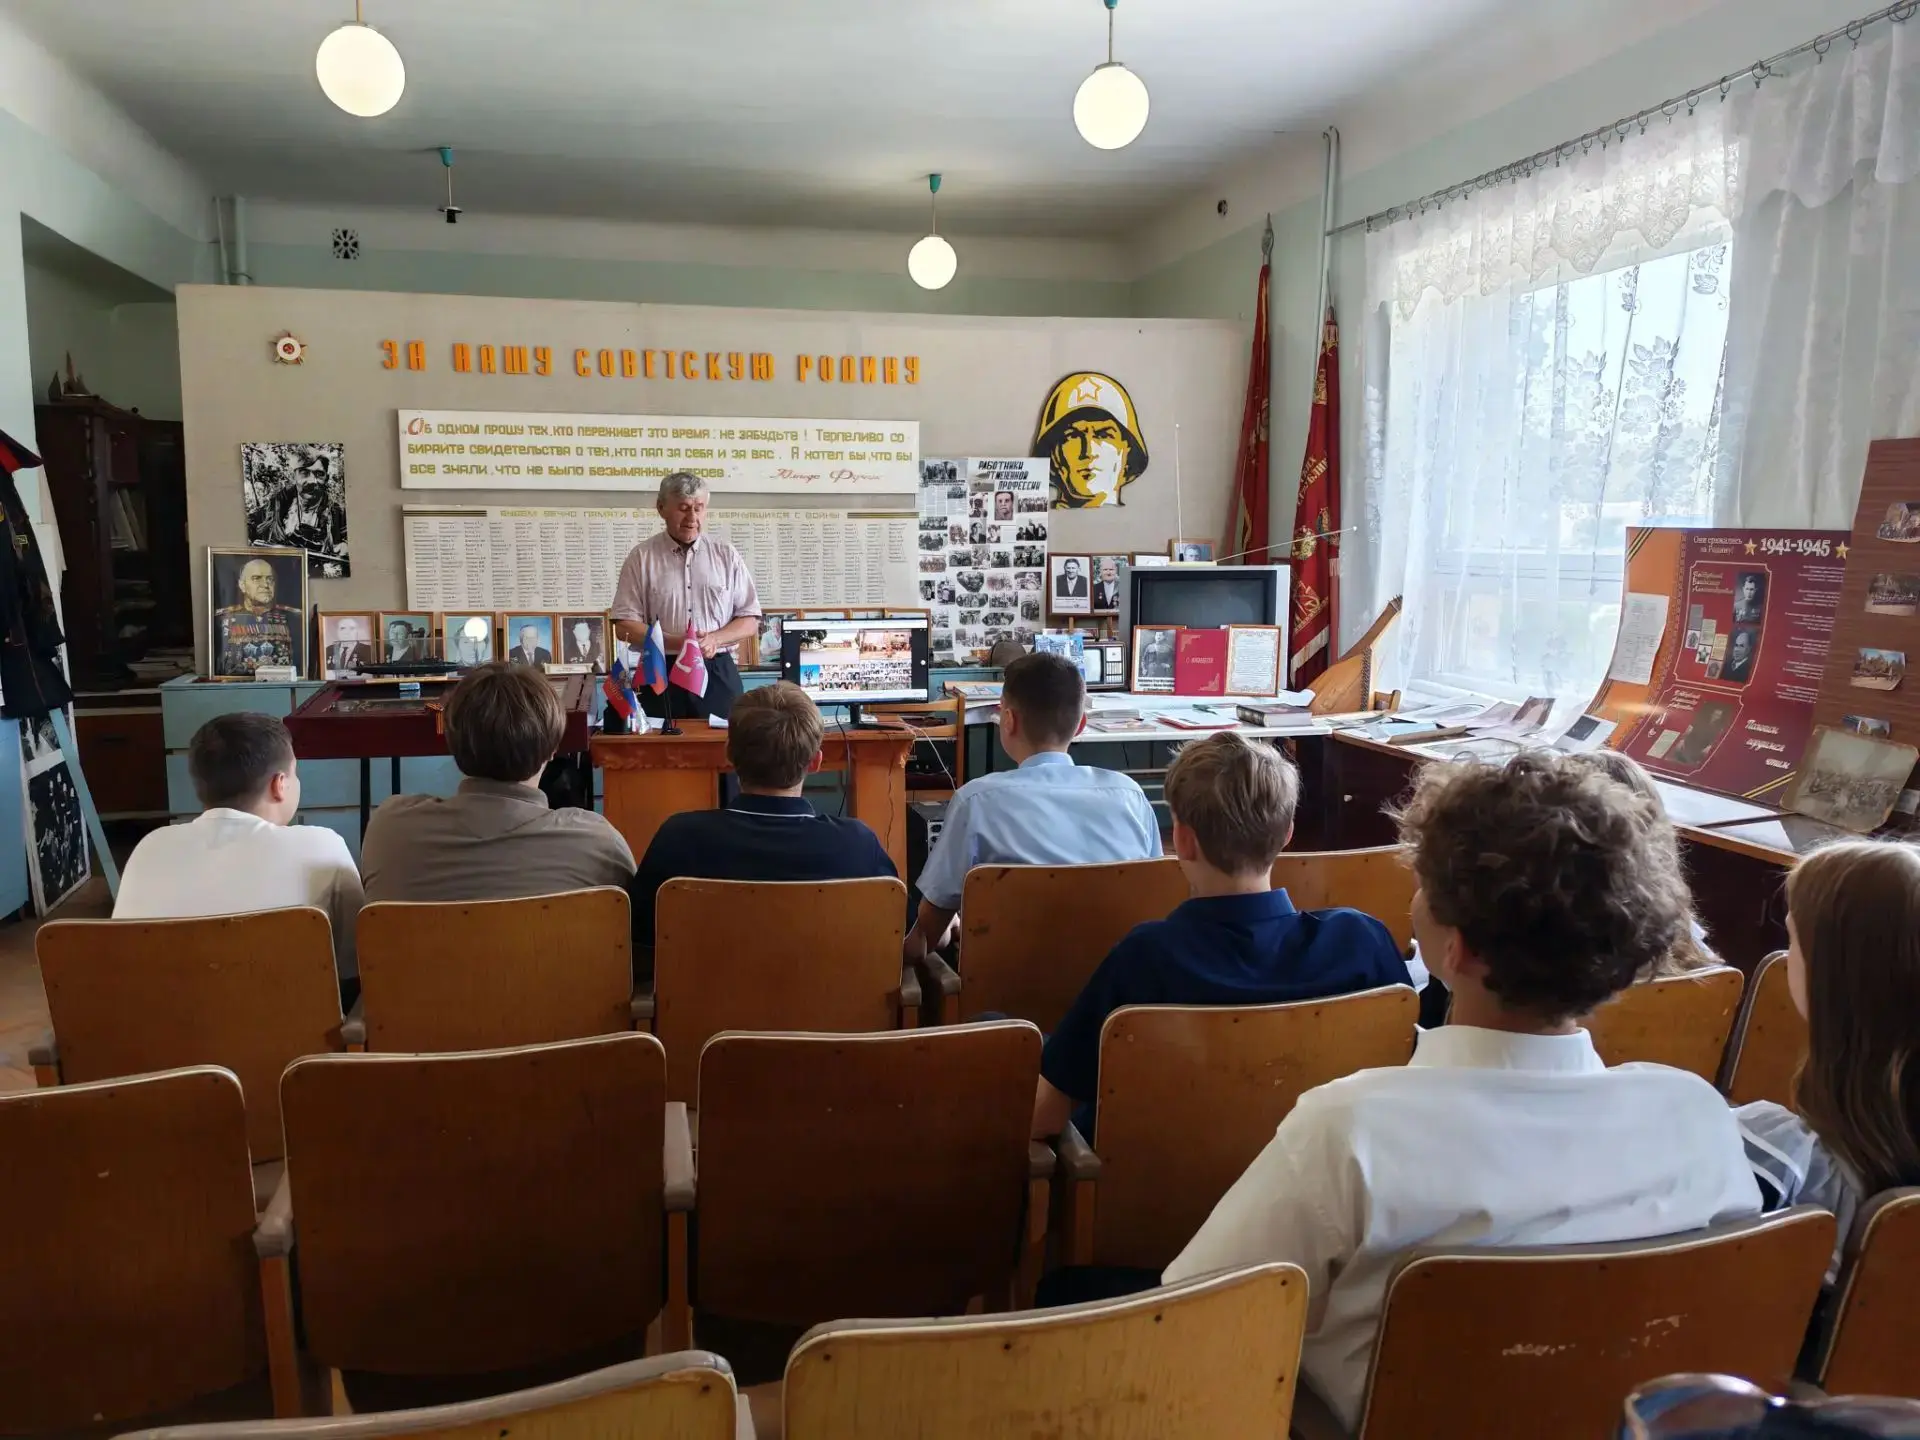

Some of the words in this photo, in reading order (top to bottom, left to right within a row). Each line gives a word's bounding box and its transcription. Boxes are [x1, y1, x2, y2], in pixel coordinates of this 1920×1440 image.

[383, 340, 426, 371] ЗА
[454, 343, 552, 376] НАШУ
[575, 348, 775, 381] СОВЕТСКУЮ
[797, 354, 920, 385] РОДИНУ
[978, 460, 1024, 470] РАБОТНИКИ
[998, 480, 1041, 490] ПРОФЕССИИ
[1760, 537, 1831, 557] 1941-1945
